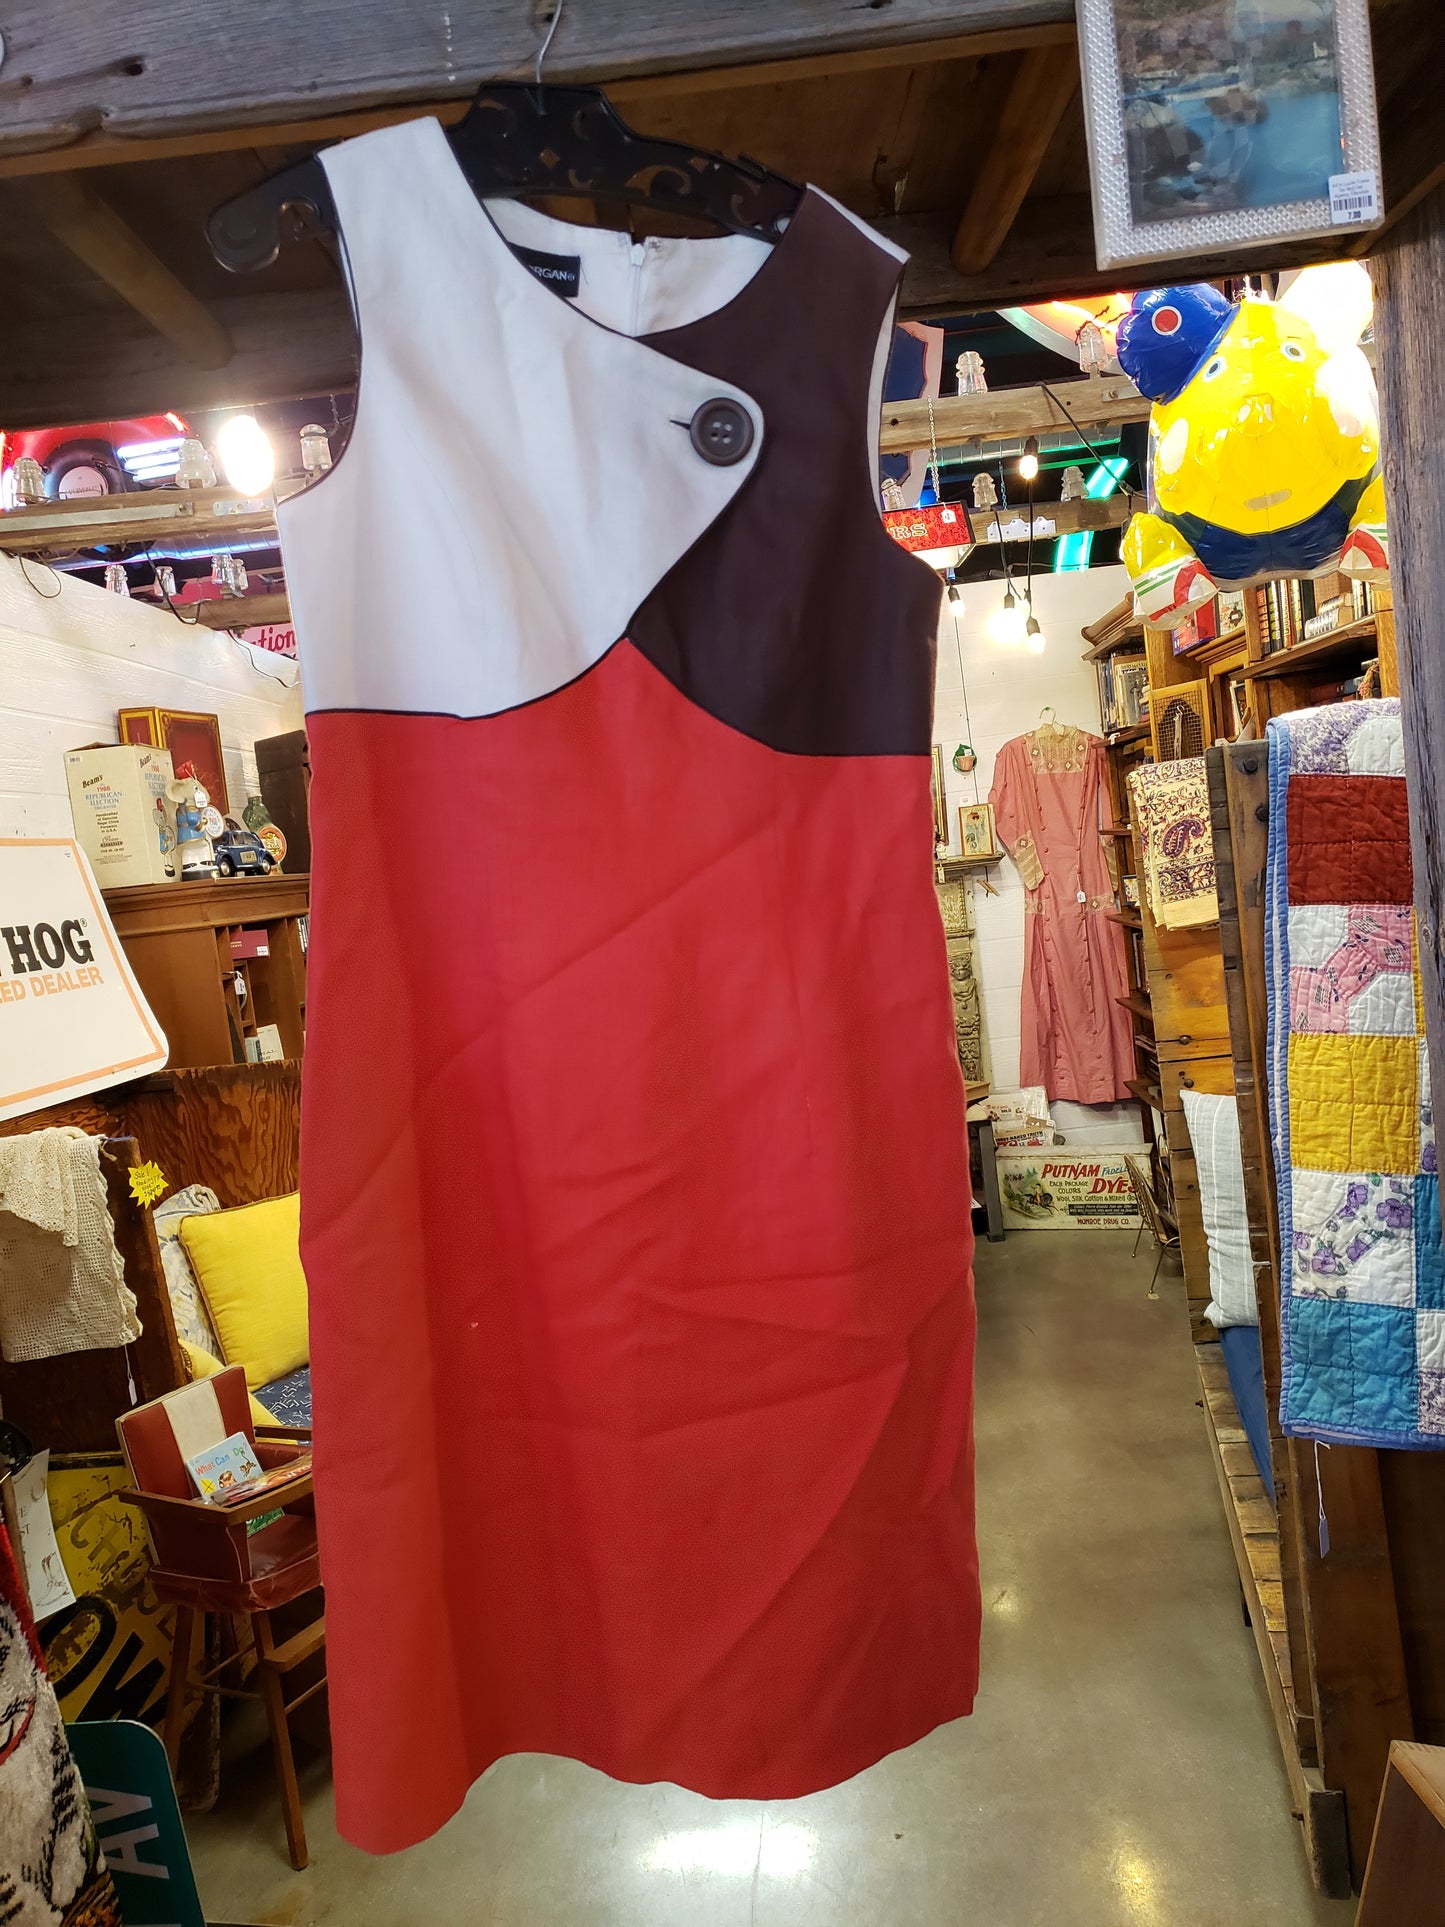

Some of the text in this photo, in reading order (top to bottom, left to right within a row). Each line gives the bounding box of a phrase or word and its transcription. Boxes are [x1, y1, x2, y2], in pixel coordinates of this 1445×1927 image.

[529, 264, 568, 281] RGAN
[888, 523, 928, 540] RS
[251, 626, 296, 652] tion
[82, 774, 103, 789] Beam's
[85, 791, 122, 801] REPUBLICAN
[90, 798, 120, 806] ELECTION
[0, 966, 104, 1004] ED DEALER
[1041, 1162, 1101, 1181] PUTNAM
[195, 1461, 216, 1476] What
[215, 1454, 230, 1466] Can
